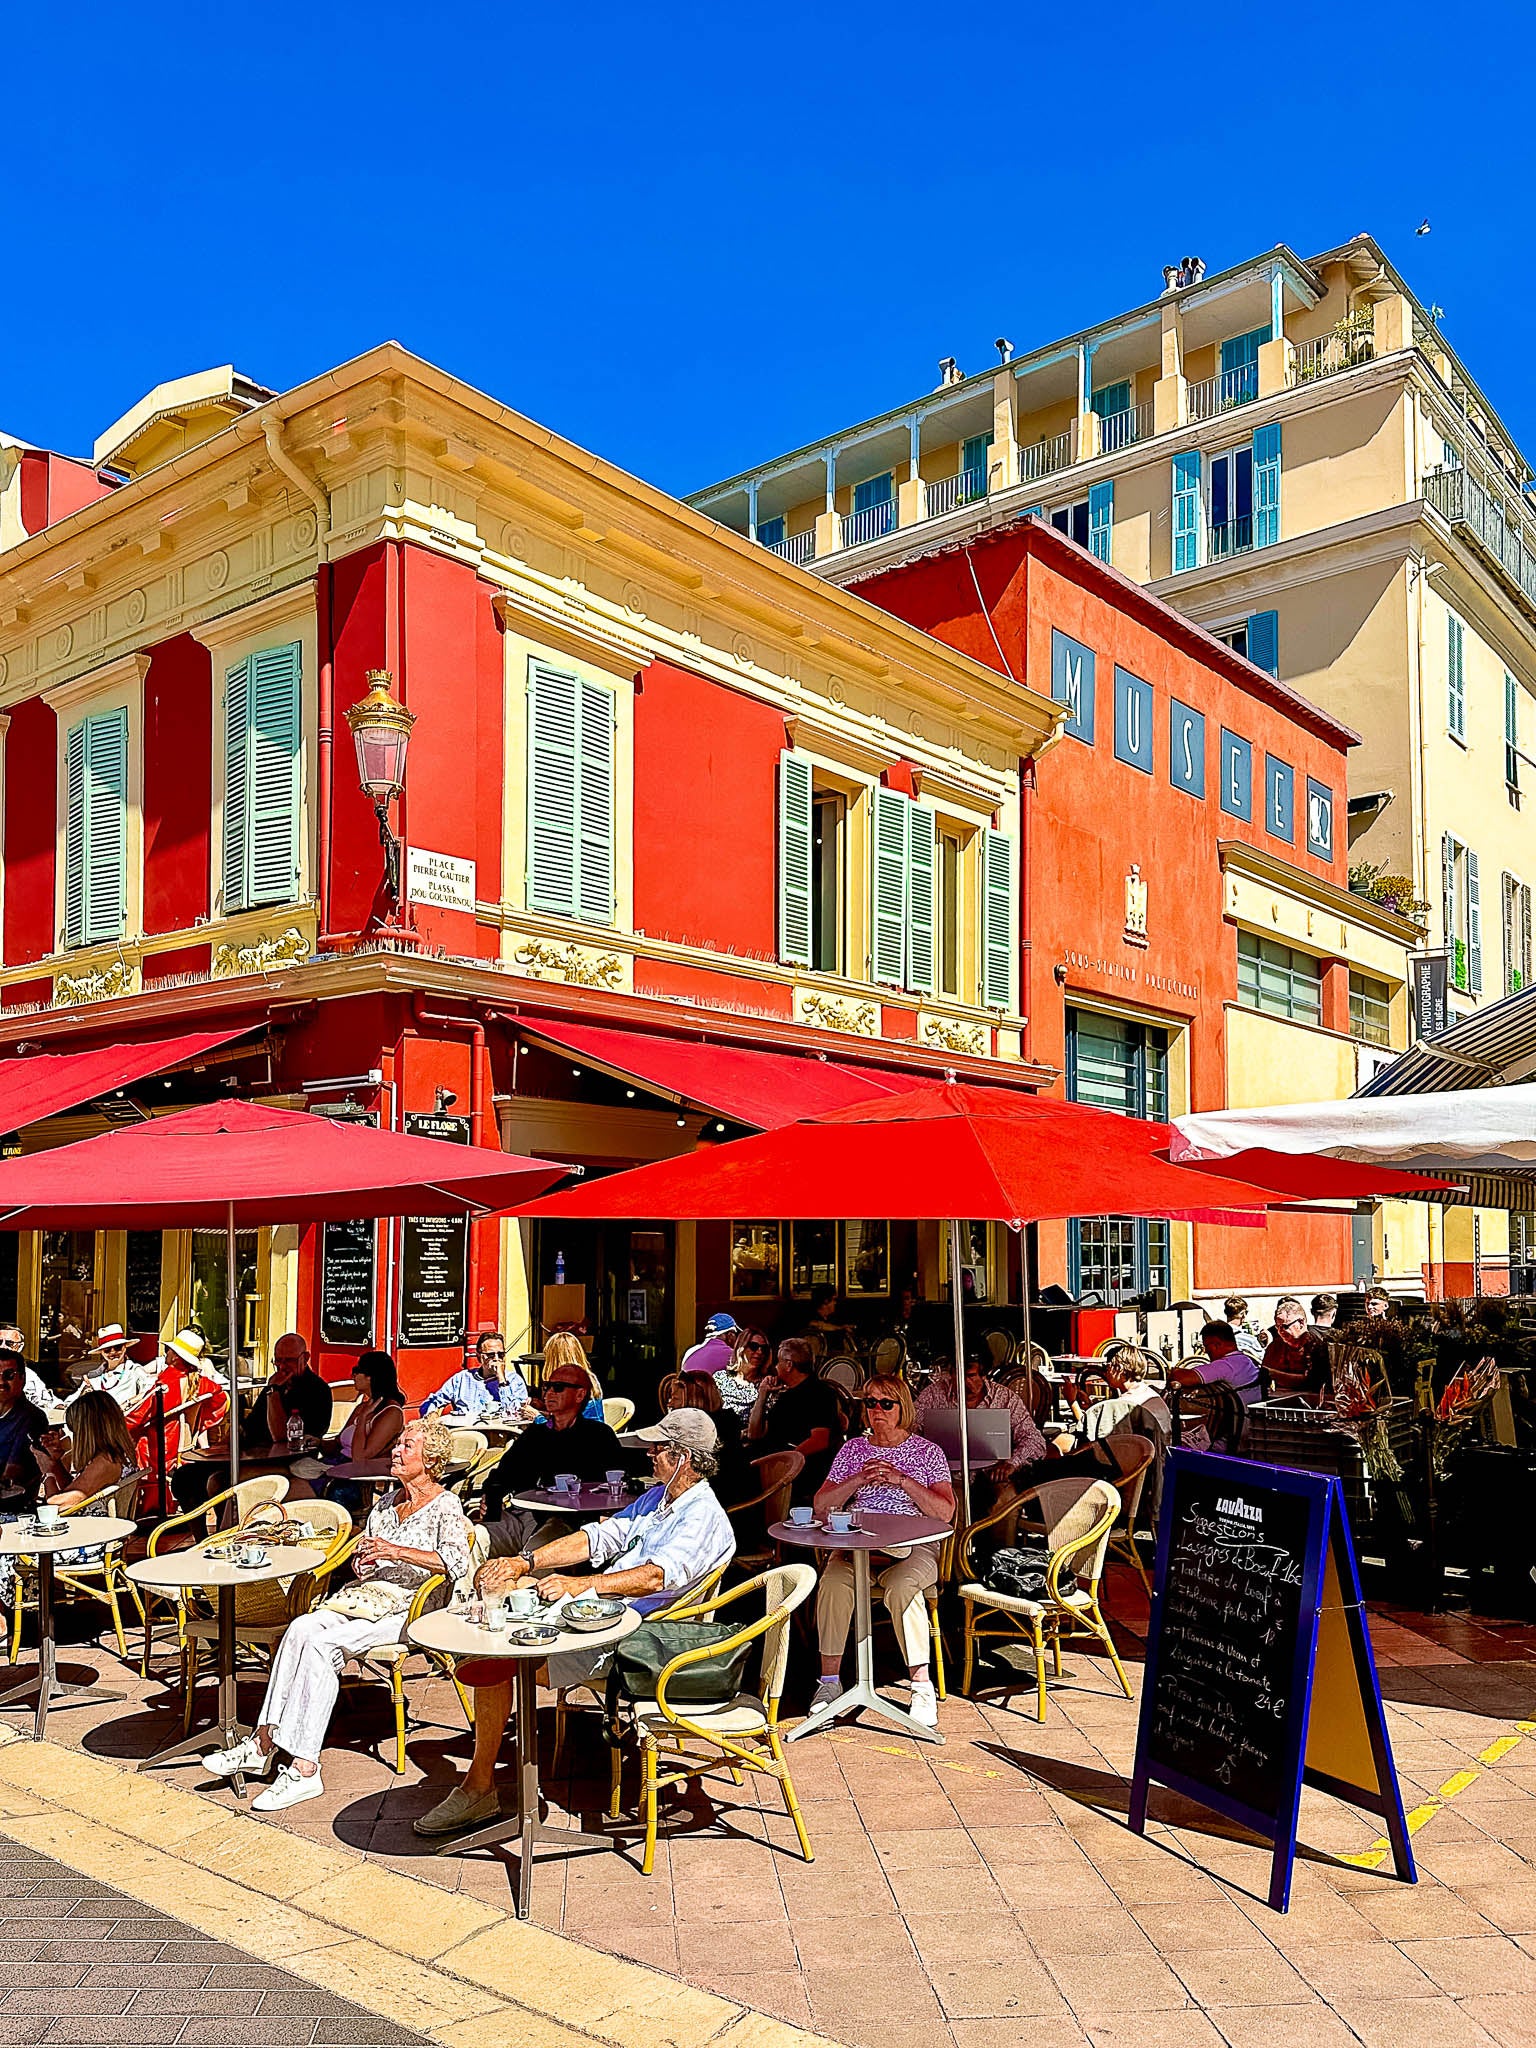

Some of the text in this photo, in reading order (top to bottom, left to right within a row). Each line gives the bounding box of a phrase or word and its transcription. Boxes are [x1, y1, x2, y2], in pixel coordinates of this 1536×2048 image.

[429, 858, 455, 870] PLACE
[413, 865, 470, 883] PIERRE GAUTIER
[428, 881, 456, 894] PLASSA
[1064, 949, 1137, 982] SOUS-STATION
[1420, 964, 1432, 1029] PHOTOGRAPHIE
[418, 1119, 430, 1130] LE
[1215, 1497, 1263, 1523] LAVAZZA
[1250, 1652, 1261, 1669] et
